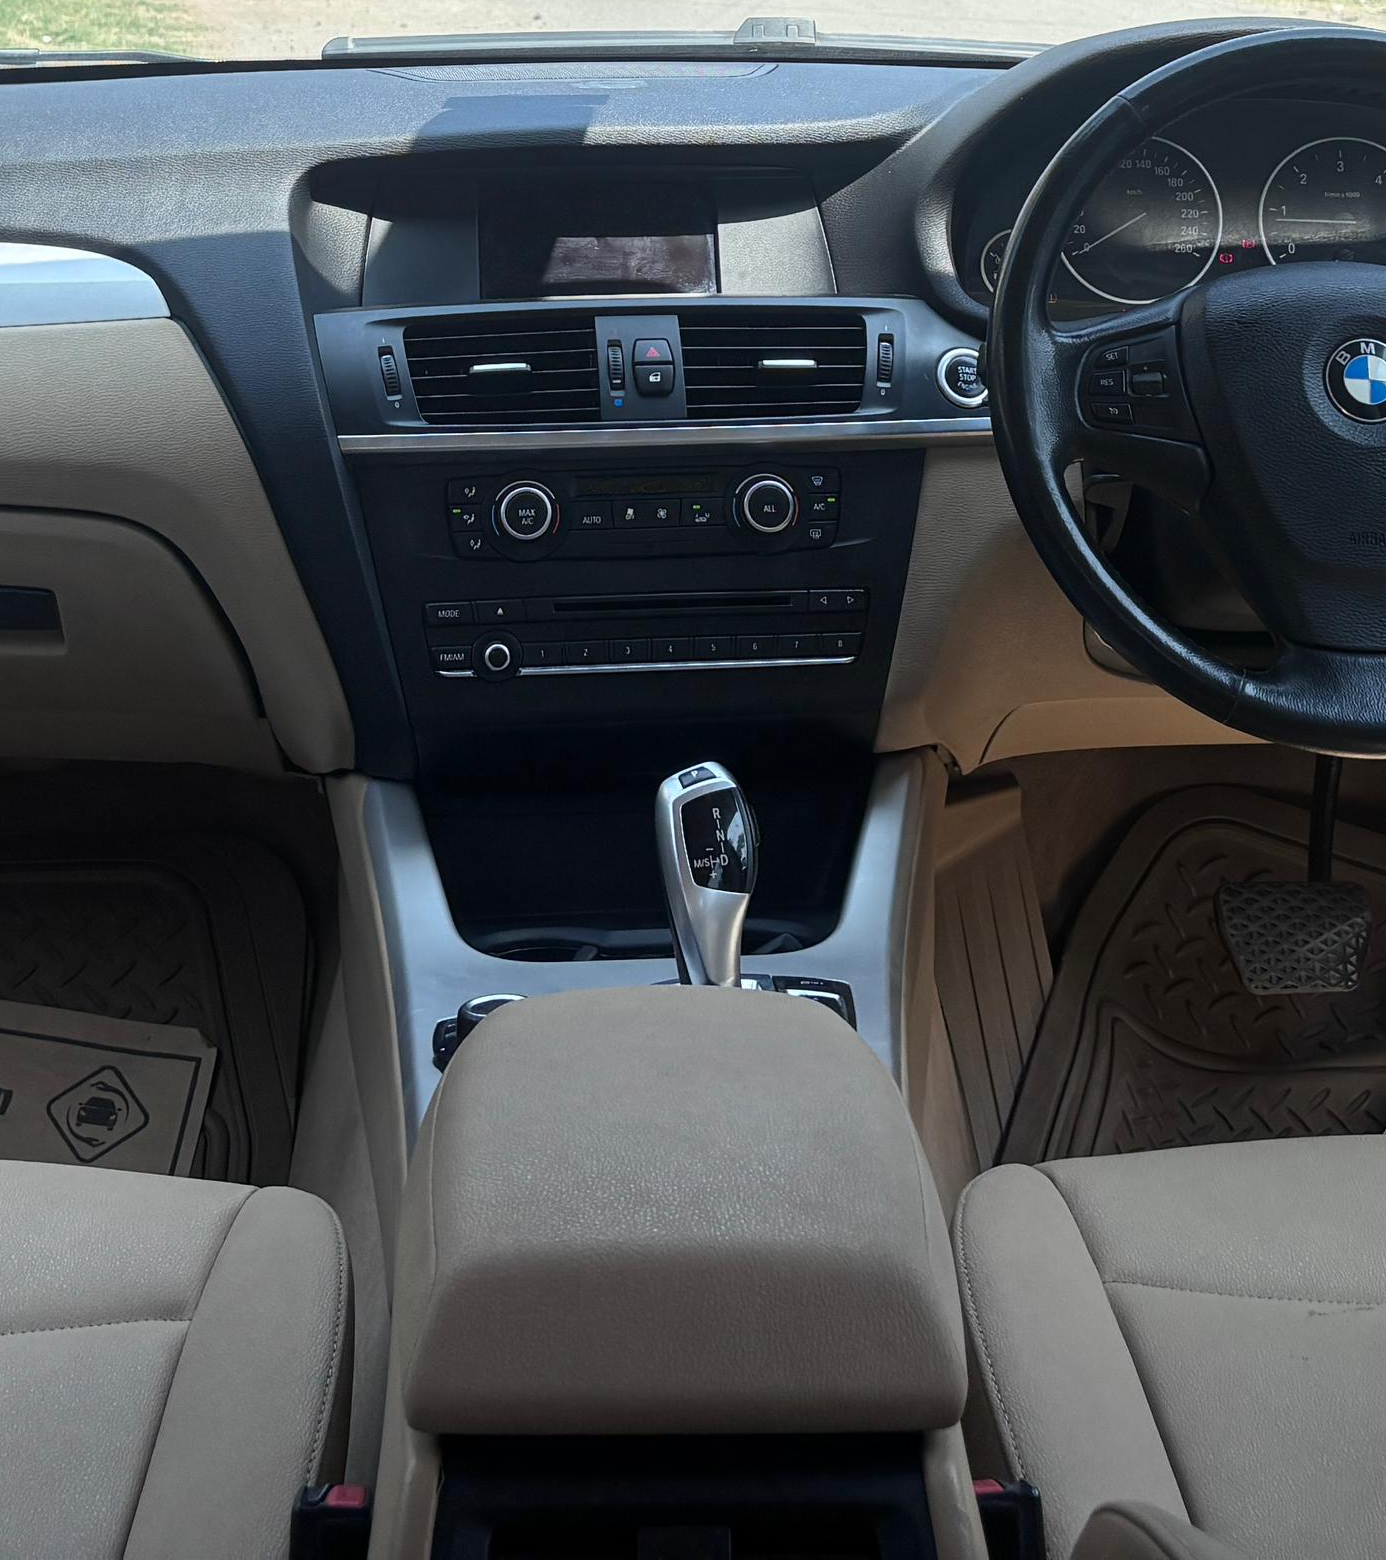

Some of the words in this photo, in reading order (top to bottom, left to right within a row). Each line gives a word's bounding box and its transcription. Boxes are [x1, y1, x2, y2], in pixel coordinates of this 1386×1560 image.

[1135, 159, 1151, 169] 140
[1337, 161, 1344, 173] 3
[1154, 166, 1170, 176] 160
[1167, 178, 1184, 187] 180
[1299, 173, 1308, 184] 2
[1375, 174, 1383, 185] 4
[1175, 192, 1194, 201] 200
[1181, 209, 1199, 218] 220
[1280, 205, 1286, 216] 1
[1073, 225, 1086, 234] 20
[1181, 226, 1199, 235] 240
[1174, 244, 1193, 253] 260
[1287, 242, 1295, 254] 0
[1105, 351, 1118, 360] SET
[957, 366, 977, 375] START
[959, 373, 976, 381] STOP
[813, 503, 825, 511] A/C
[518, 509, 536, 517] MAX
[521, 517, 534, 525] A/C
[582, 516, 602, 524] AUTO
[438, 609, 459, 618] MODE
[691, 770, 698, 778] P
[712, 808, 721, 819] R
[716, 830, 725, 842] N
[693, 858, 710, 868] M/S
[721, 854, 729, 866] D
